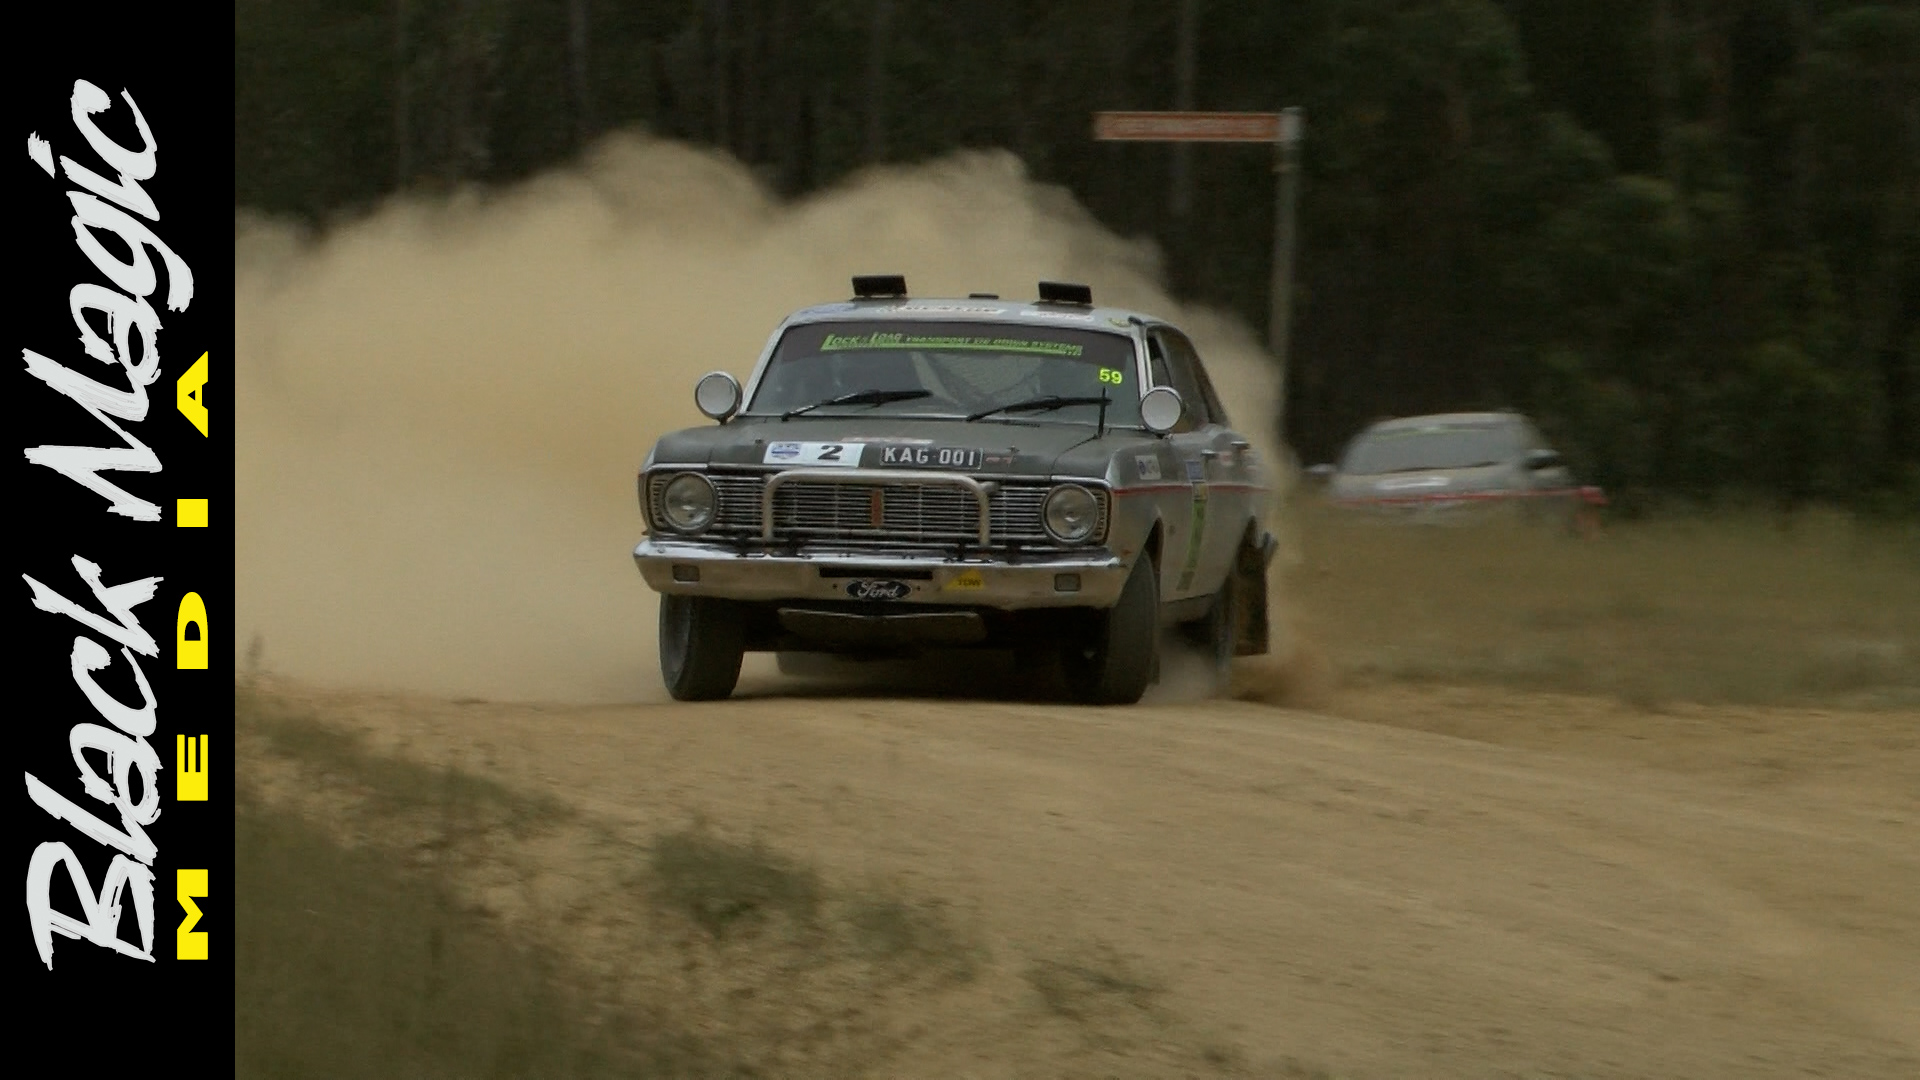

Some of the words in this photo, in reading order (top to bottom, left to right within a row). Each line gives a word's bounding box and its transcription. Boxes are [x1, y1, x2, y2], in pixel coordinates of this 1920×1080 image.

[1099, 368, 1122, 384] 59
[817, 444, 844, 460] 2
[884, 447, 928, 464] KAG
[939, 448, 975, 466] 001
[857, 580, 899, 598] Ford
